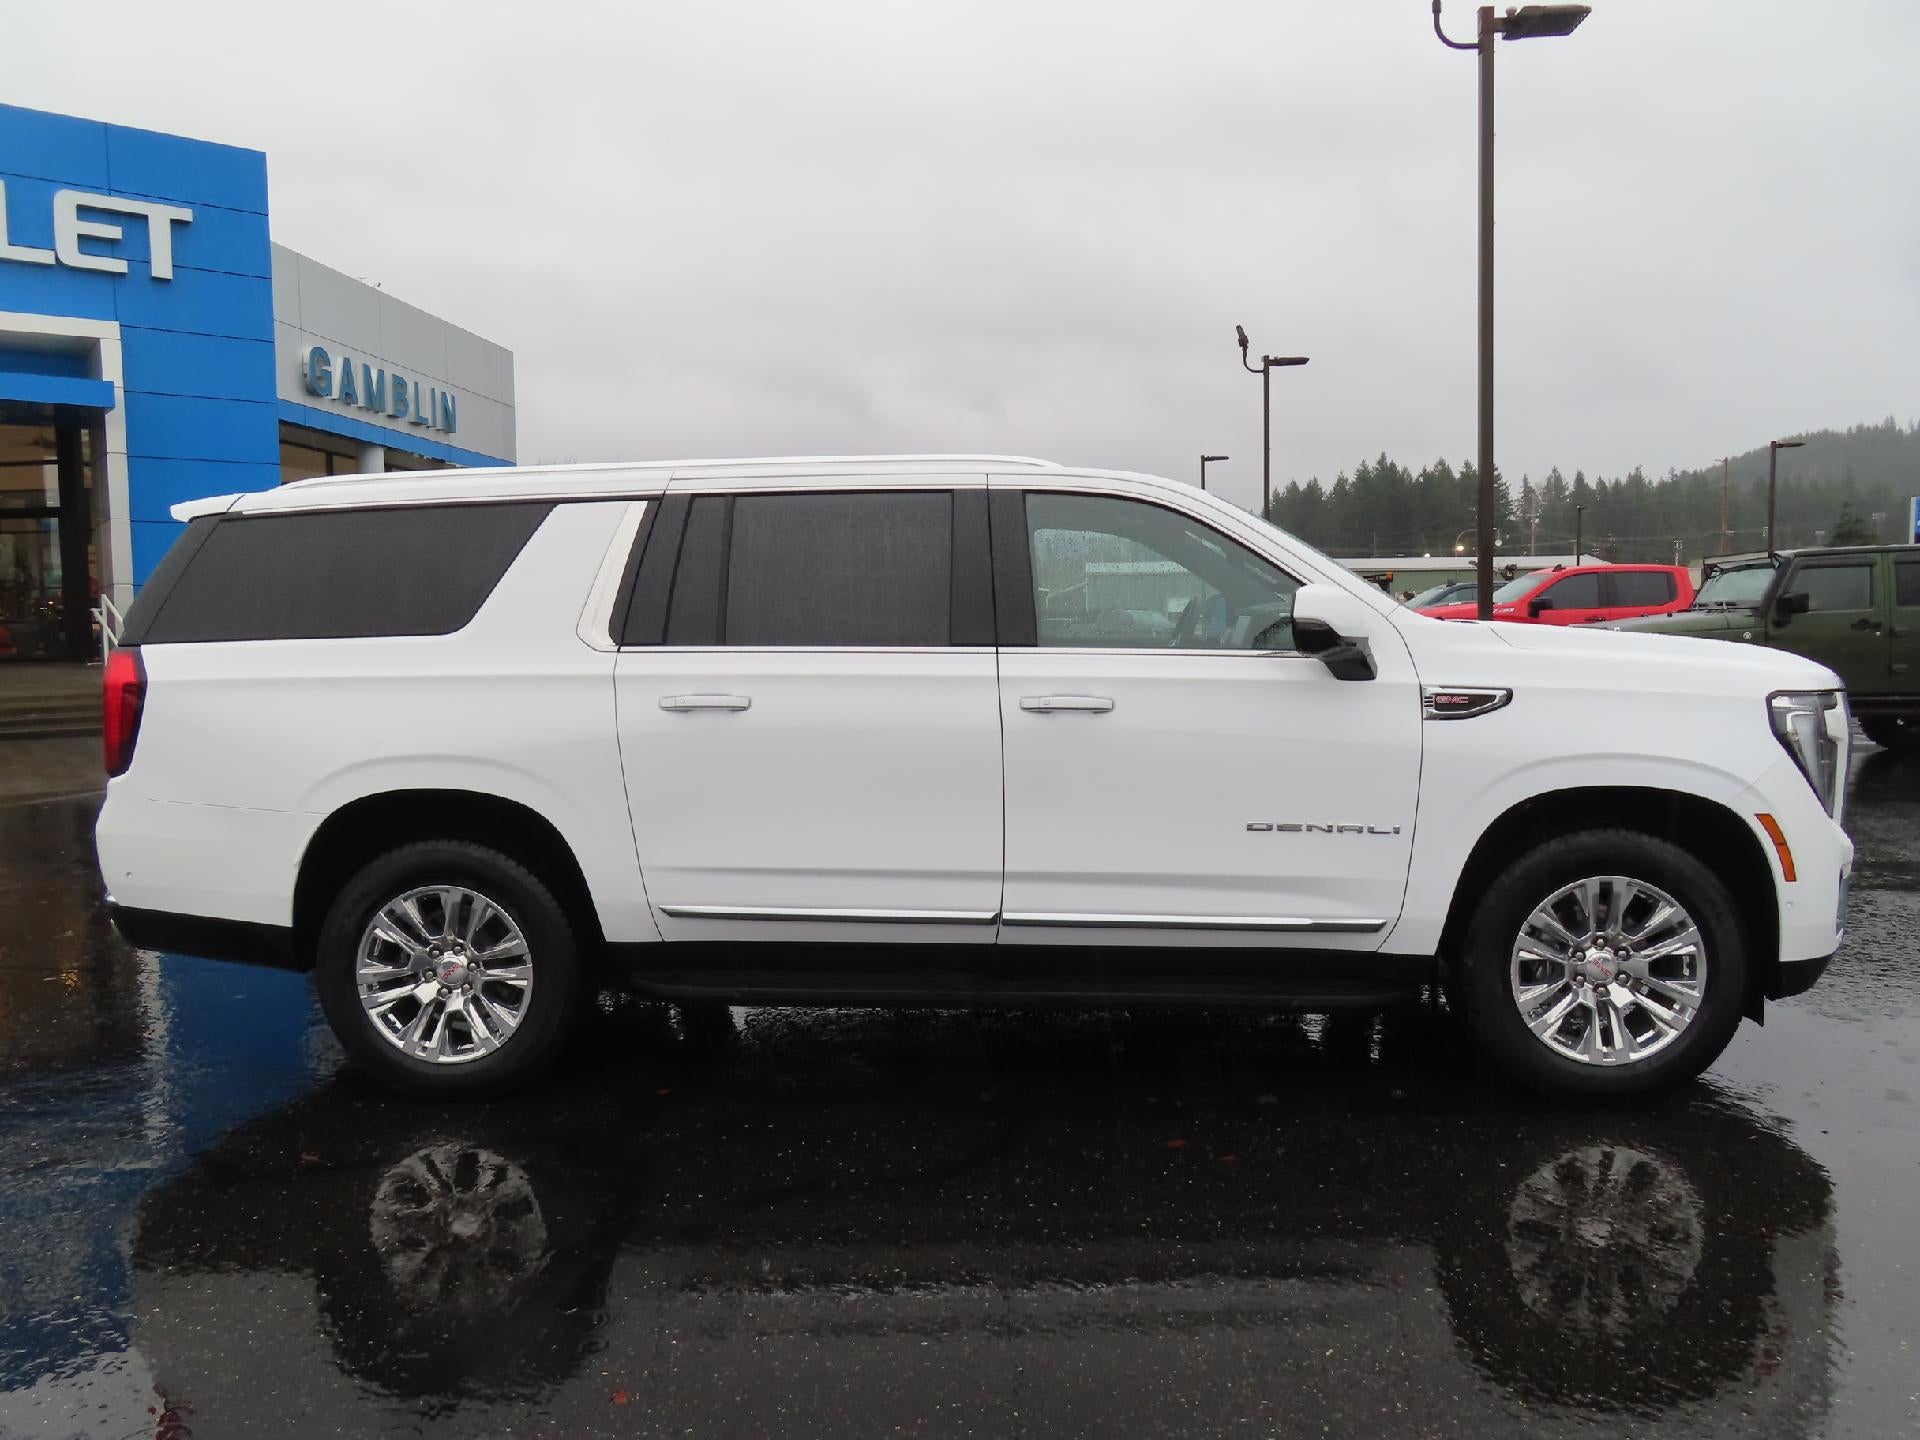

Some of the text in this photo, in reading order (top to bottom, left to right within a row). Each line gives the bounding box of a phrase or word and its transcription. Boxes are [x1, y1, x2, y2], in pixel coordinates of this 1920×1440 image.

[304, 346, 457, 434] GAMBLIN
[1436, 695, 1469, 704] GMC
[1246, 821, 1401, 834] DENALI
